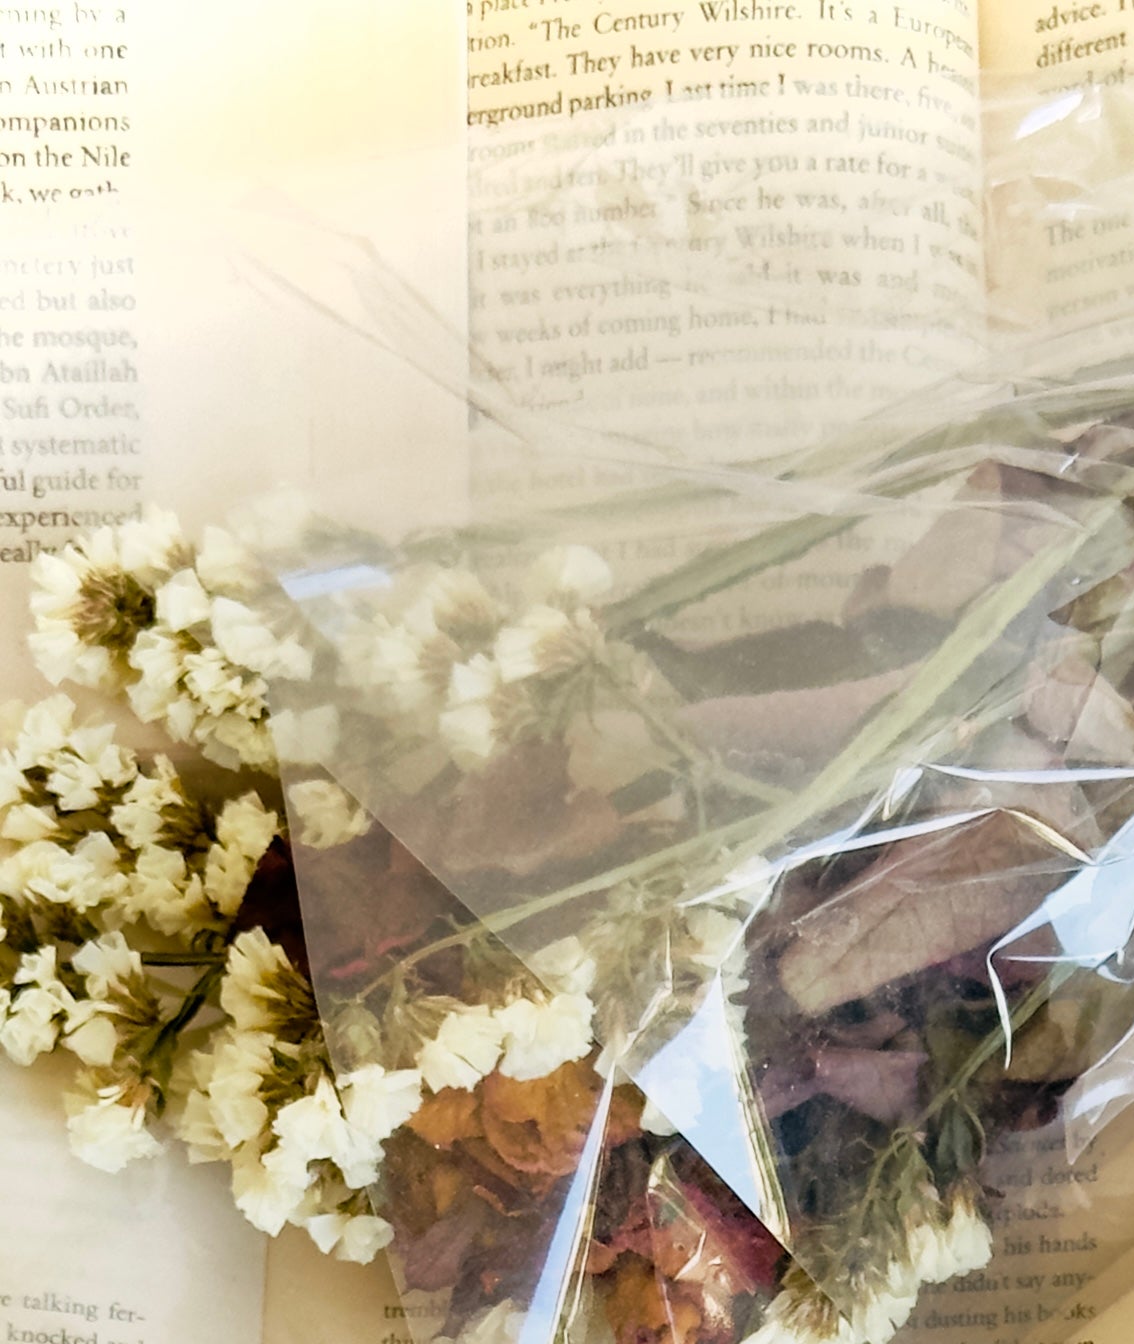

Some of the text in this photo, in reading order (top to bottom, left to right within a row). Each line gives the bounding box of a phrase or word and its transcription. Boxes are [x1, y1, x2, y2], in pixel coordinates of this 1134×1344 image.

[565, 50, 622, 79] They
[629, 44, 681, 69] have
[689, 44, 740, 68] very
[749, 42, 797, 59] nice
[1035, 31, 1127, 69] different
[34, 143, 131, 168] the Nile
